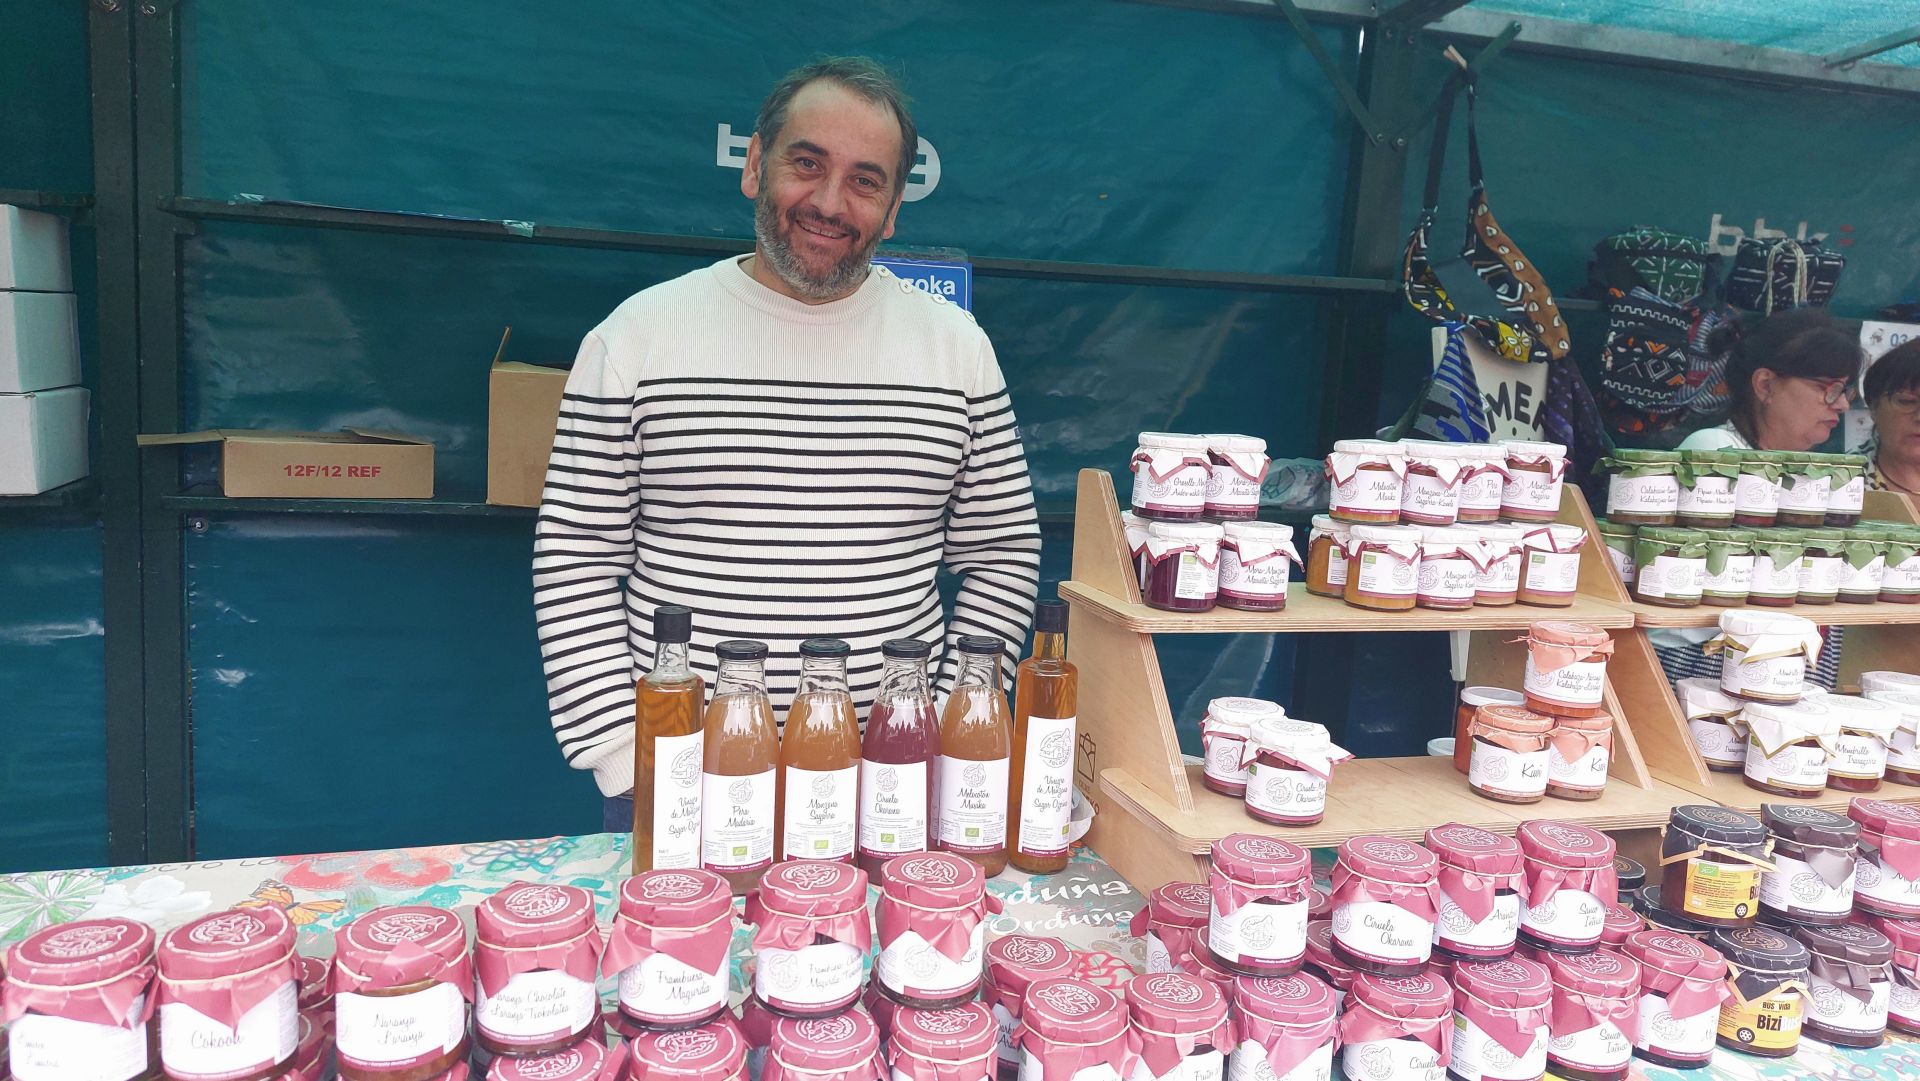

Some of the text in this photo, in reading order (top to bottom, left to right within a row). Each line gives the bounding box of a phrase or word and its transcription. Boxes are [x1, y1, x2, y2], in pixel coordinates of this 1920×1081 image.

[283, 465, 381, 477] 12F/12 REF
[1364, 915, 1394, 932] Ciruela
